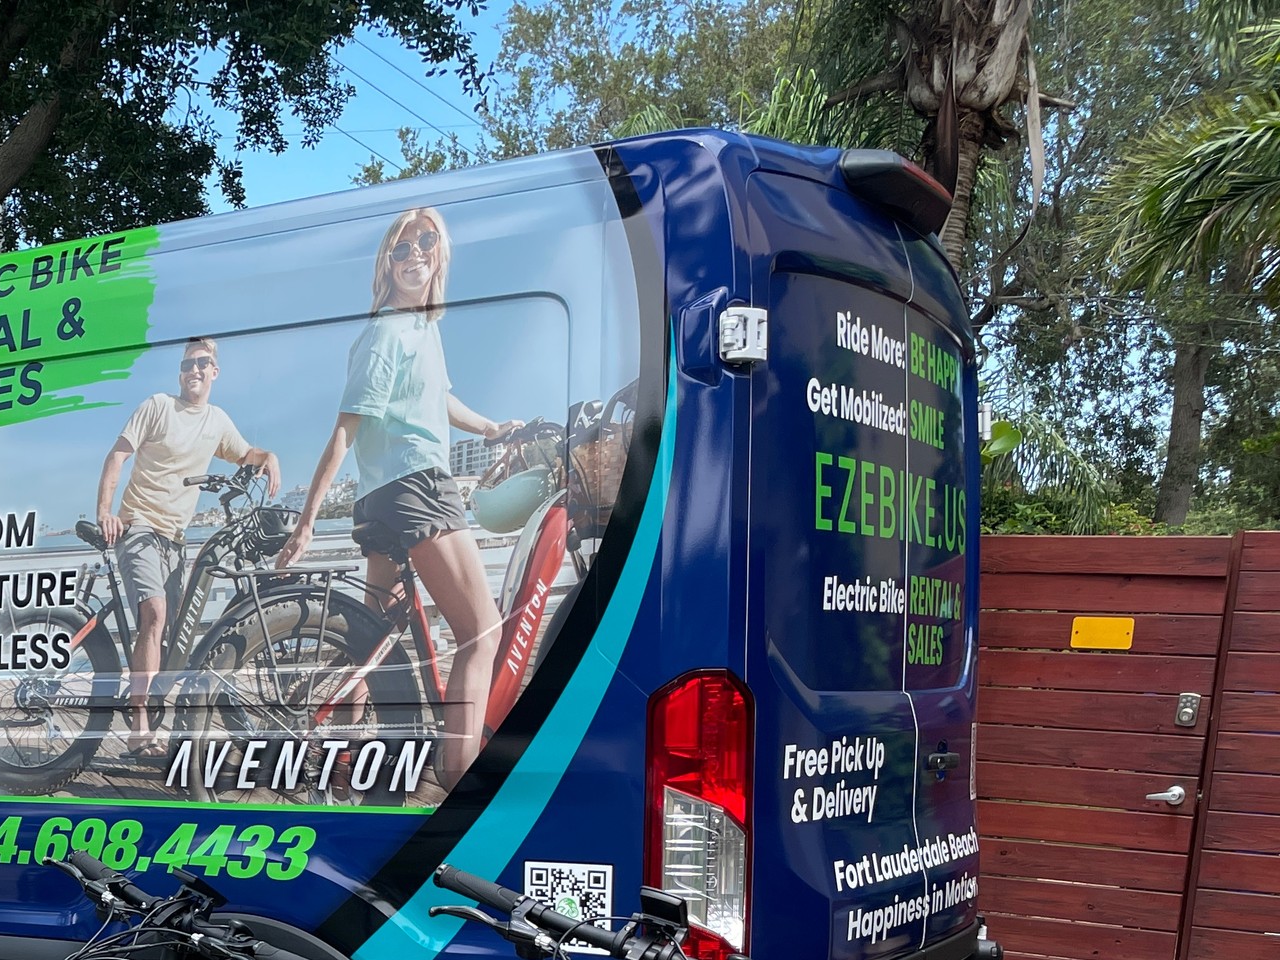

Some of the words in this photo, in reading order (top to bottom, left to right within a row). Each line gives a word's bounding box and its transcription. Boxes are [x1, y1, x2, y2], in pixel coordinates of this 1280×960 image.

[29, 236, 126, 291] BIKE
[56, 298, 85, 340] &
[836, 311, 868, 355] Ride
[871, 324, 905, 370] More:
[910, 332, 925, 379] BE
[807, 378, 838, 417] Get
[840, 385, 906, 436] Mobilized:
[910, 400, 944, 449] SMILE
[815, 451, 966, 555] EZEBIKE.US
[177, 586, 205, 654] AVENTON
[823, 575, 877, 613] Electric
[879, 578, 904, 614] Bike
[909, 575, 952, 619] RENTAL
[953, 584, 961, 620] &
[507, 579, 547, 676] AVENTON
[907, 623, 943, 665] SALES
[54, 697, 89, 706] AVENTON
[165, 739, 433, 793] AVENTON
[783, 744, 828, 779] Free
[831, 736, 863, 774] Pick
[866, 737, 885, 779] Up
[791, 788, 808, 823] &
[812, 779, 877, 823] Delivery
[834, 854, 873, 892] Fort
[872, 834, 950, 882] Lauderdale
[948, 826, 979, 862] Beach
[847, 892, 930, 944] Happiness
[931, 883, 943, 915] in
